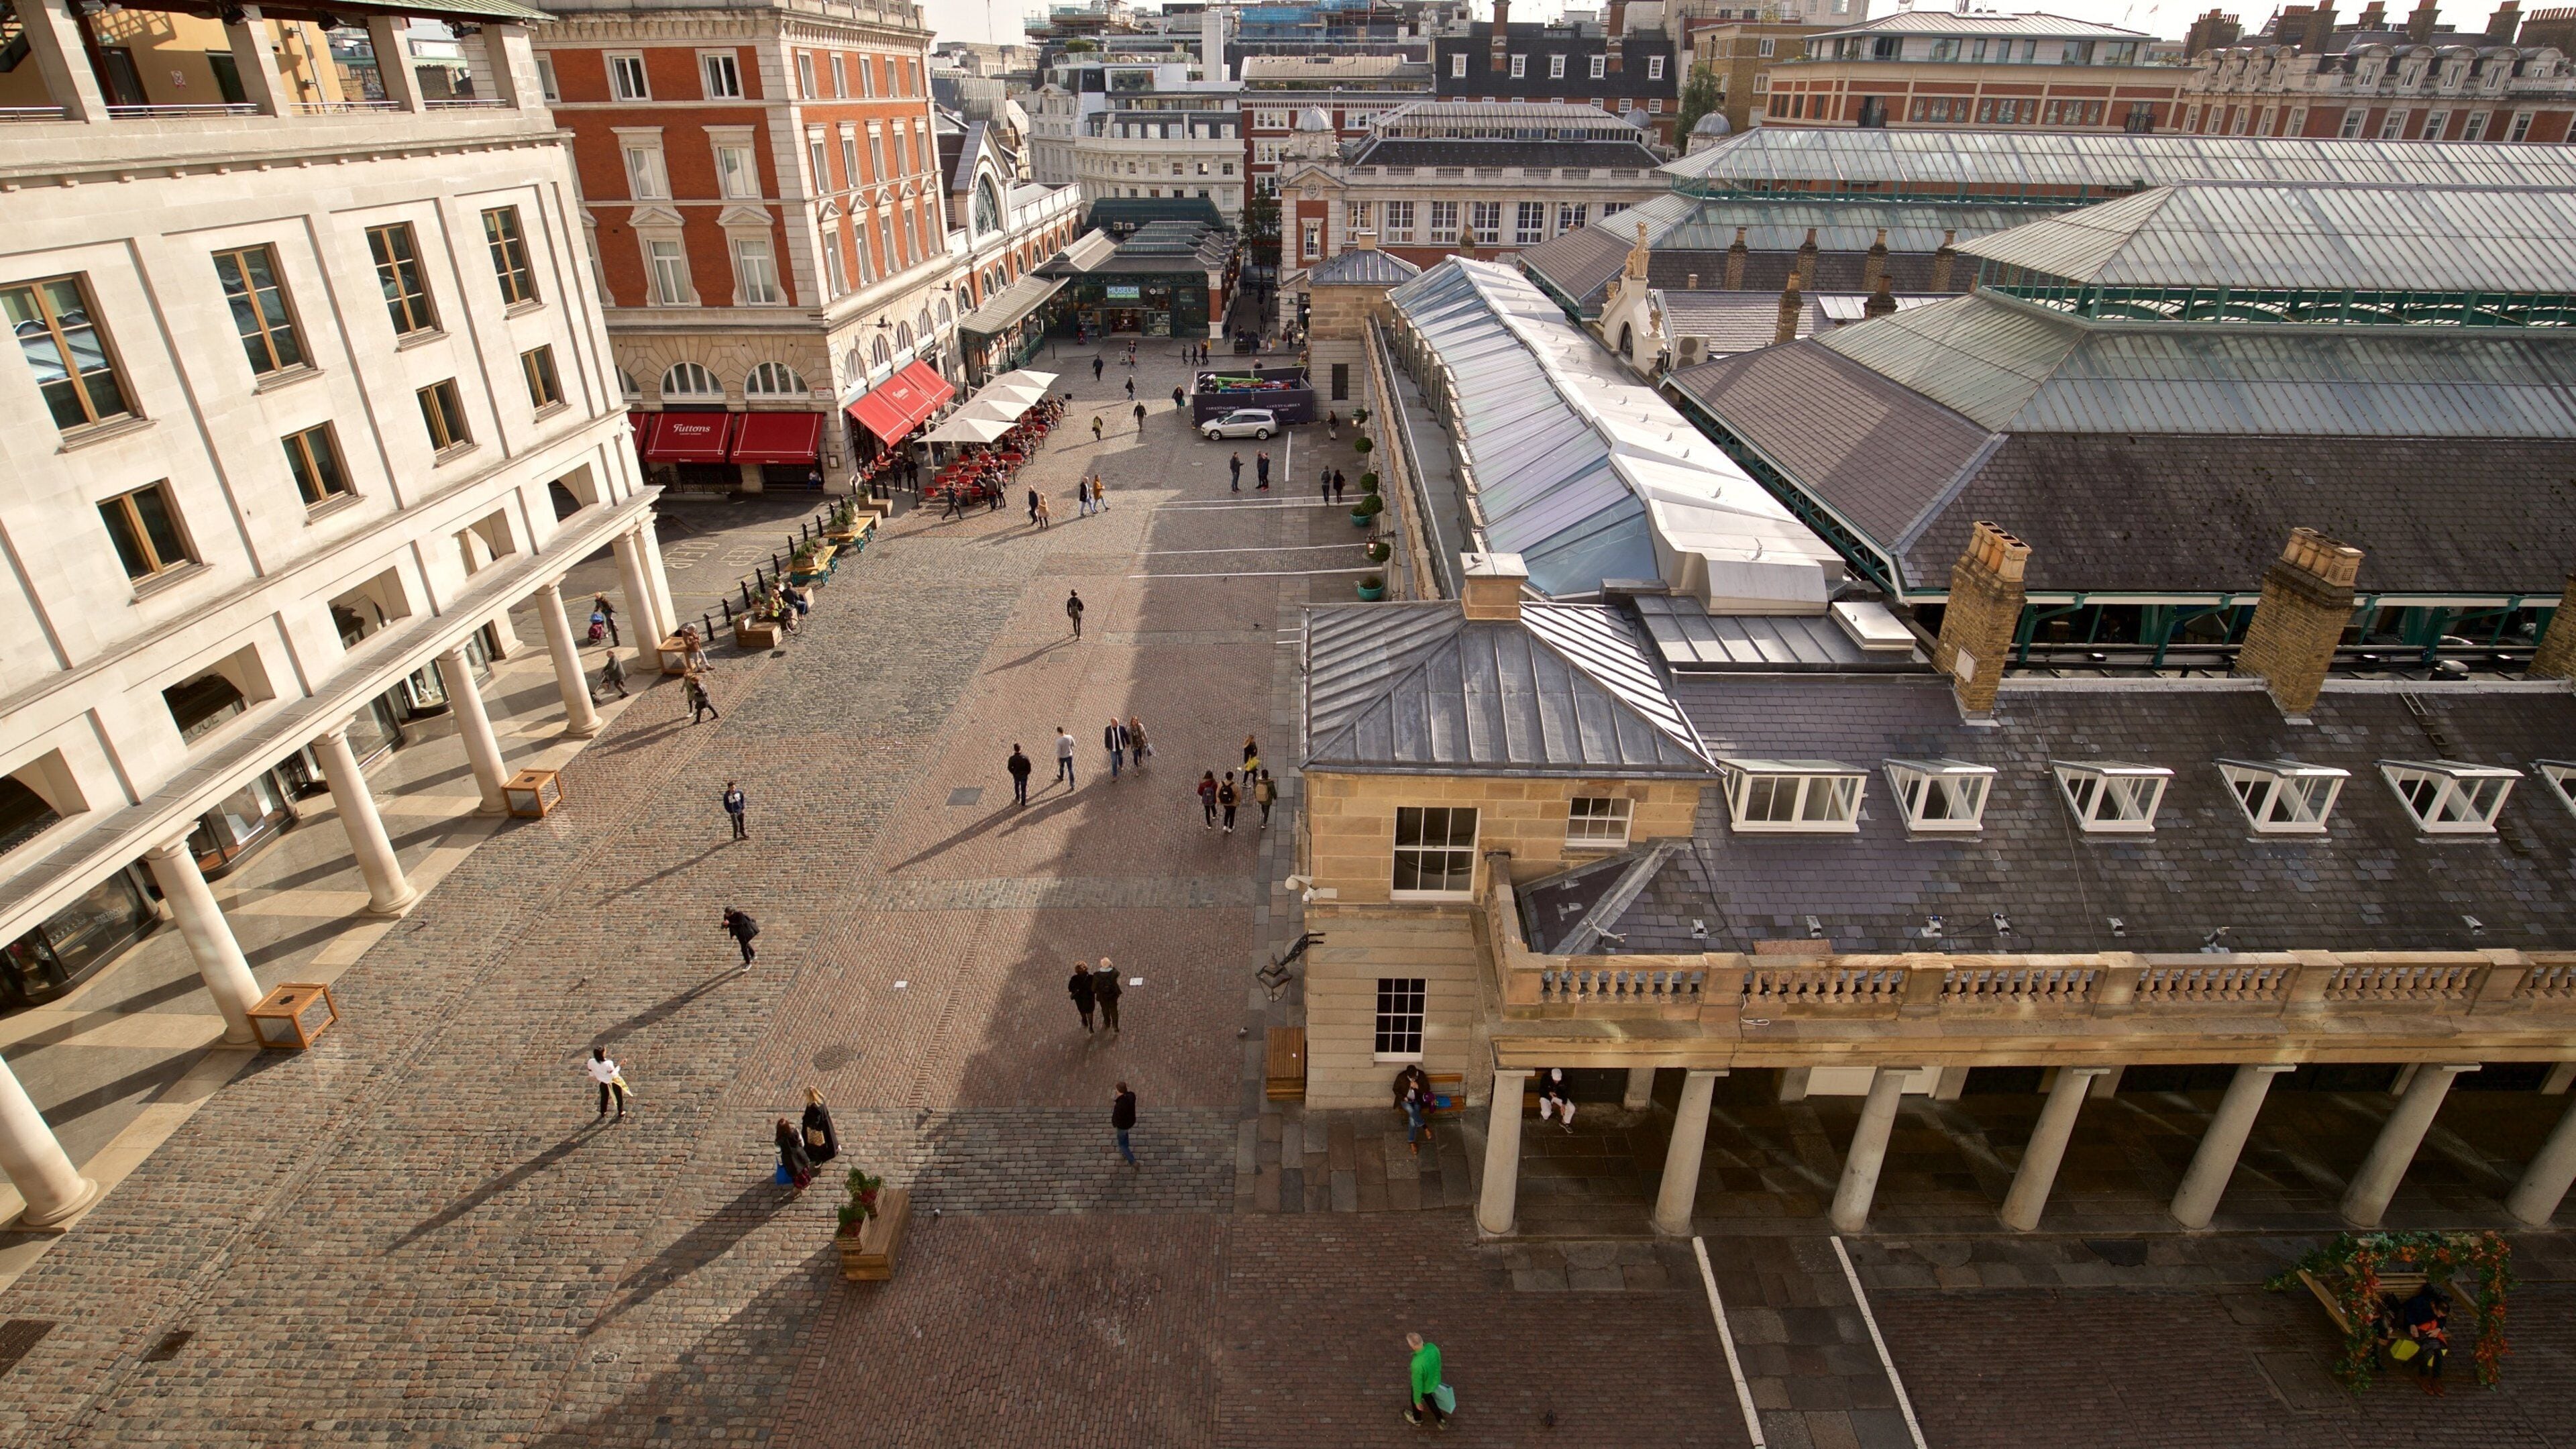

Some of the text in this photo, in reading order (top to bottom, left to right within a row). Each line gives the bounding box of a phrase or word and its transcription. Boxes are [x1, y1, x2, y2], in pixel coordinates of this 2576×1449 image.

[674, 423, 711, 433] Tuttons
[662, 541, 719, 569] CLEAR
[718, 545, 769, 566] KEEP
